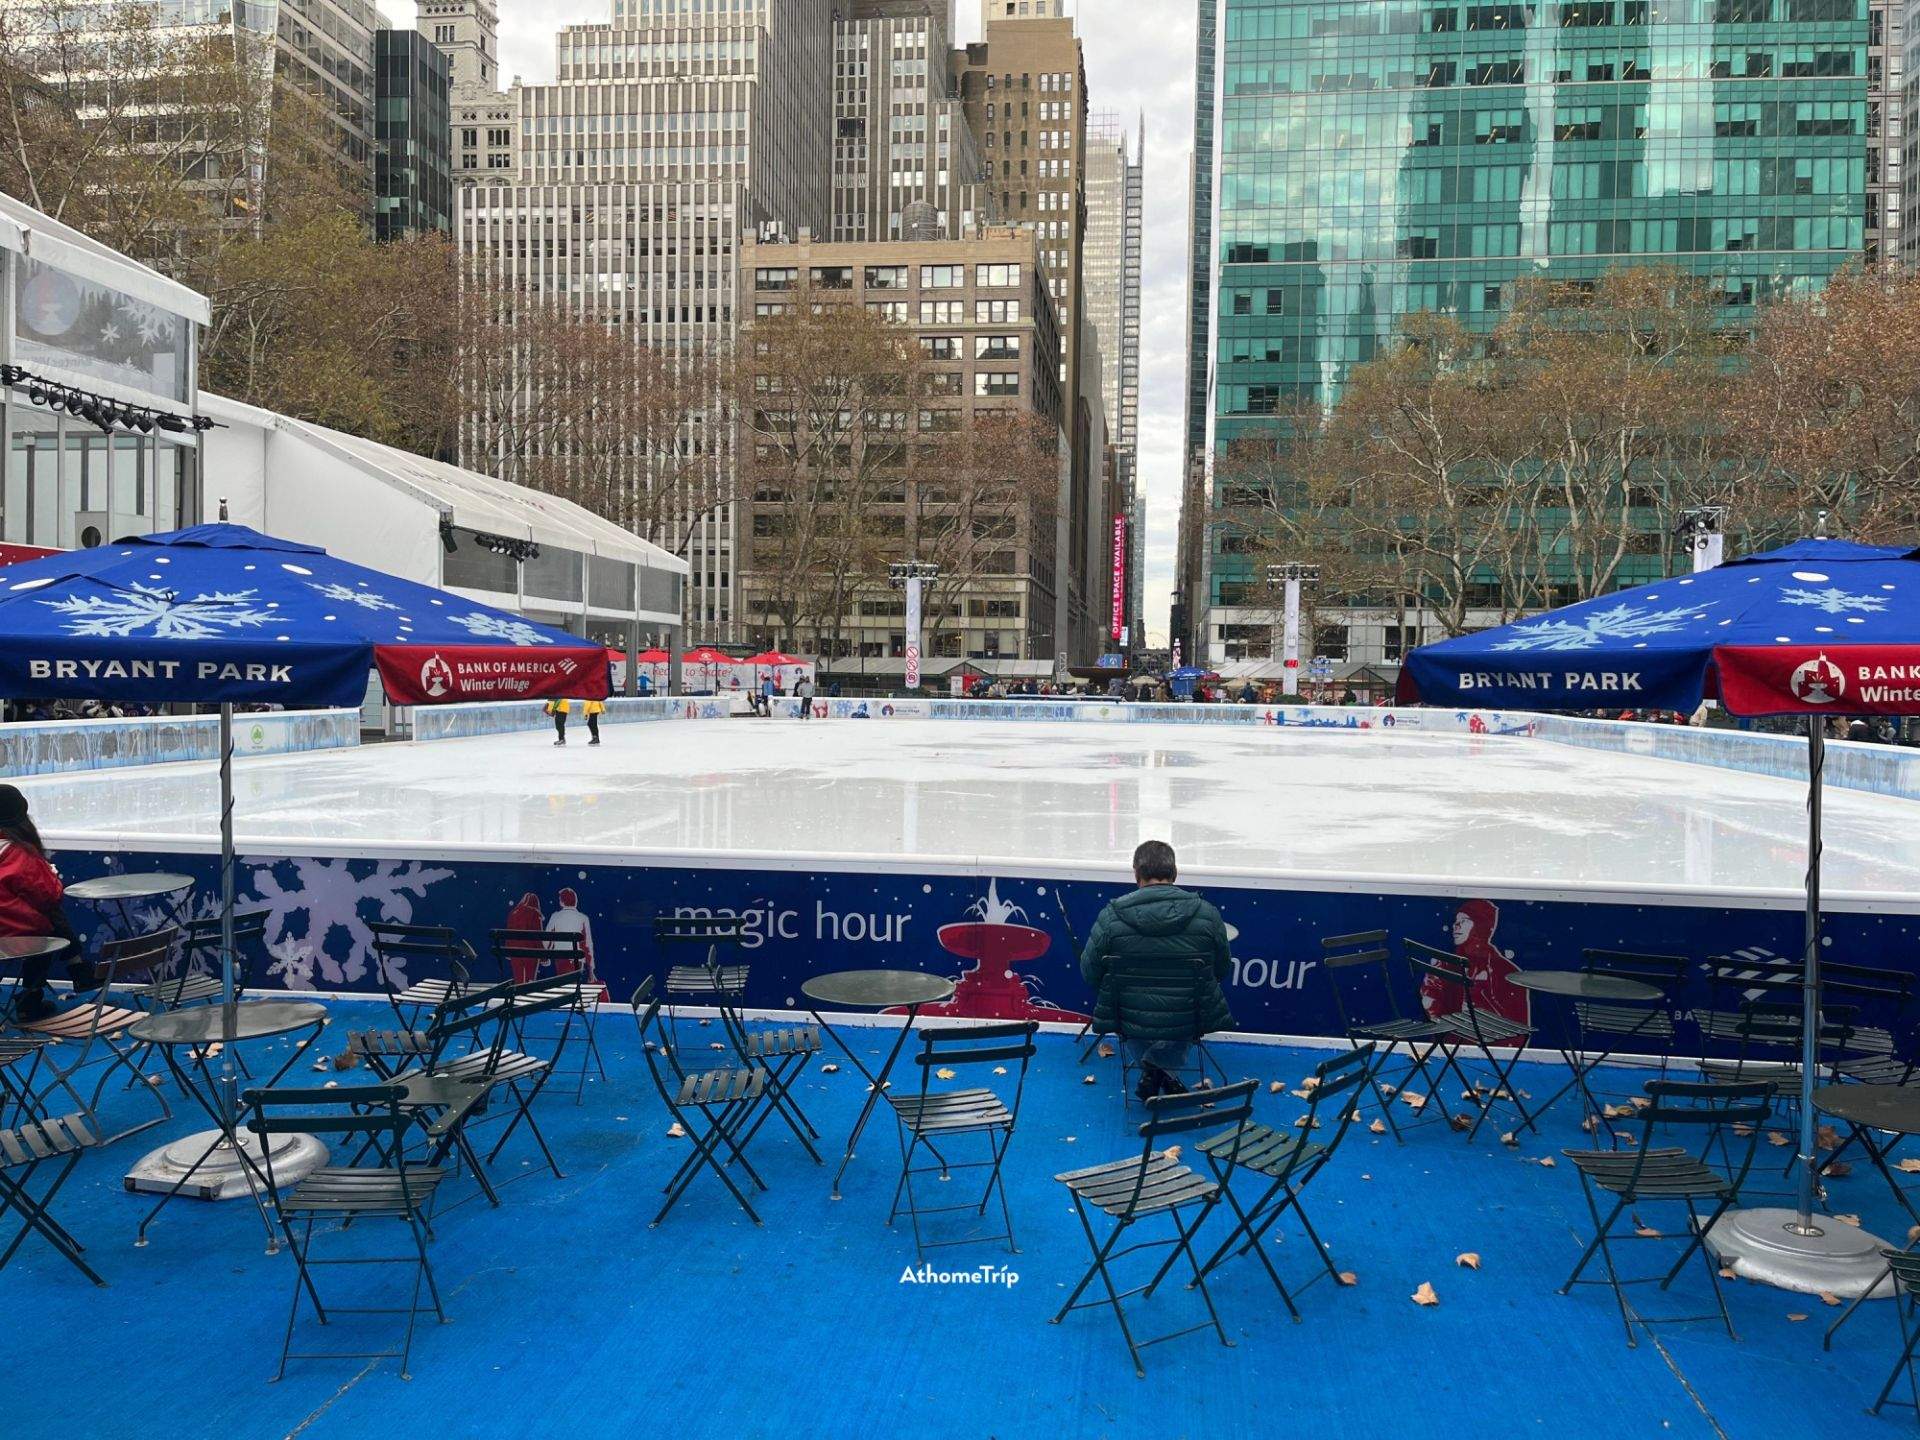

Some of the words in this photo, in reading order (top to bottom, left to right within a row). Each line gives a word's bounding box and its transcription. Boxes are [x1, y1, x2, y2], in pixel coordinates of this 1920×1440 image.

[1114, 518, 1122, 567] AVAILABLE
[29, 659, 180, 679] BRYANT
[198, 661, 293, 683] PARK
[457, 662, 491, 674] BANK
[493, 661, 508, 673] OF
[510, 661, 556, 674] AMERICA
[1858, 665, 1920, 680] BANK
[460, 678, 496, 692] Winter
[498, 677, 530, 693] Village
[1458, 672, 1552, 689] BRYANT
[1565, 672, 1643, 690] PARK
[1860, 686, 1920, 703] Winte
[674, 900, 800, 948] magic
[816, 900, 912, 942] hour
